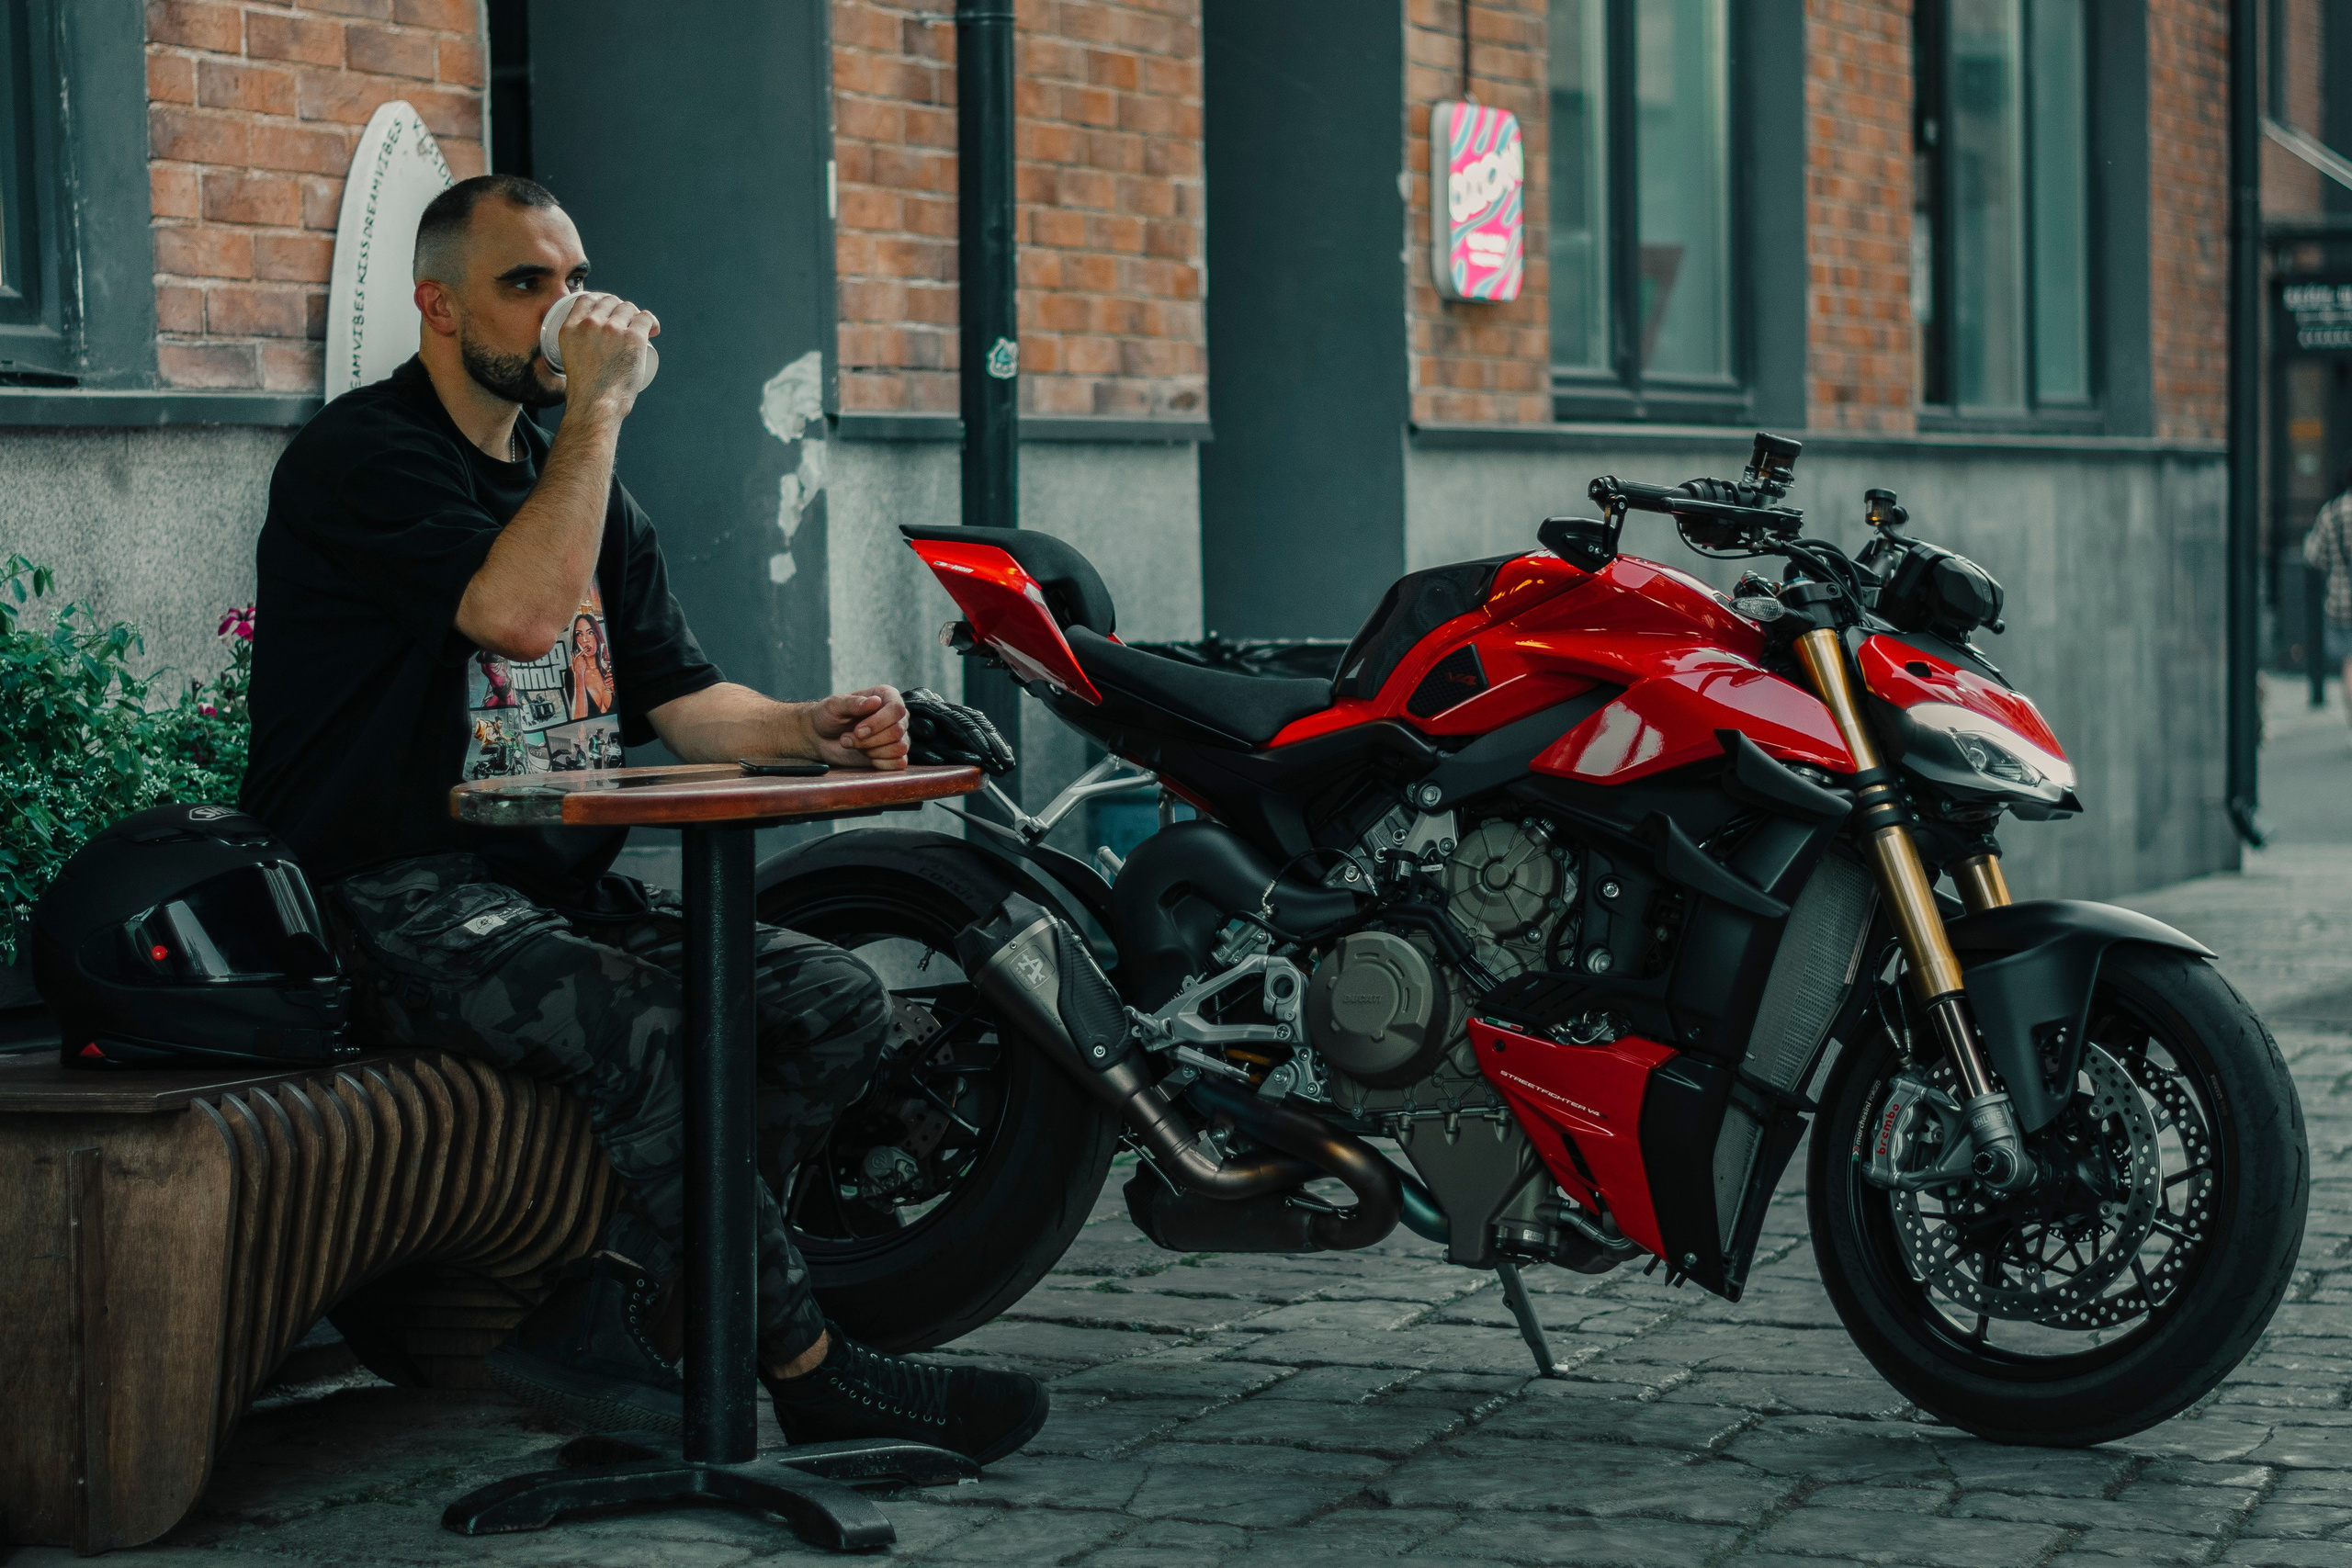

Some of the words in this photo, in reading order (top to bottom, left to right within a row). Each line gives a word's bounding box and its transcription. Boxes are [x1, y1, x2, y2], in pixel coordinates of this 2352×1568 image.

[1341, 993, 1383, 1004] DUCATI
[1500, 1070, 1587, 1111] STREETFIGHTER
[1856, 1101, 1871, 1145] marchesini
[1869, 1079, 1882, 1102] FORGED
[1876, 1103, 1900, 1156] brembo
